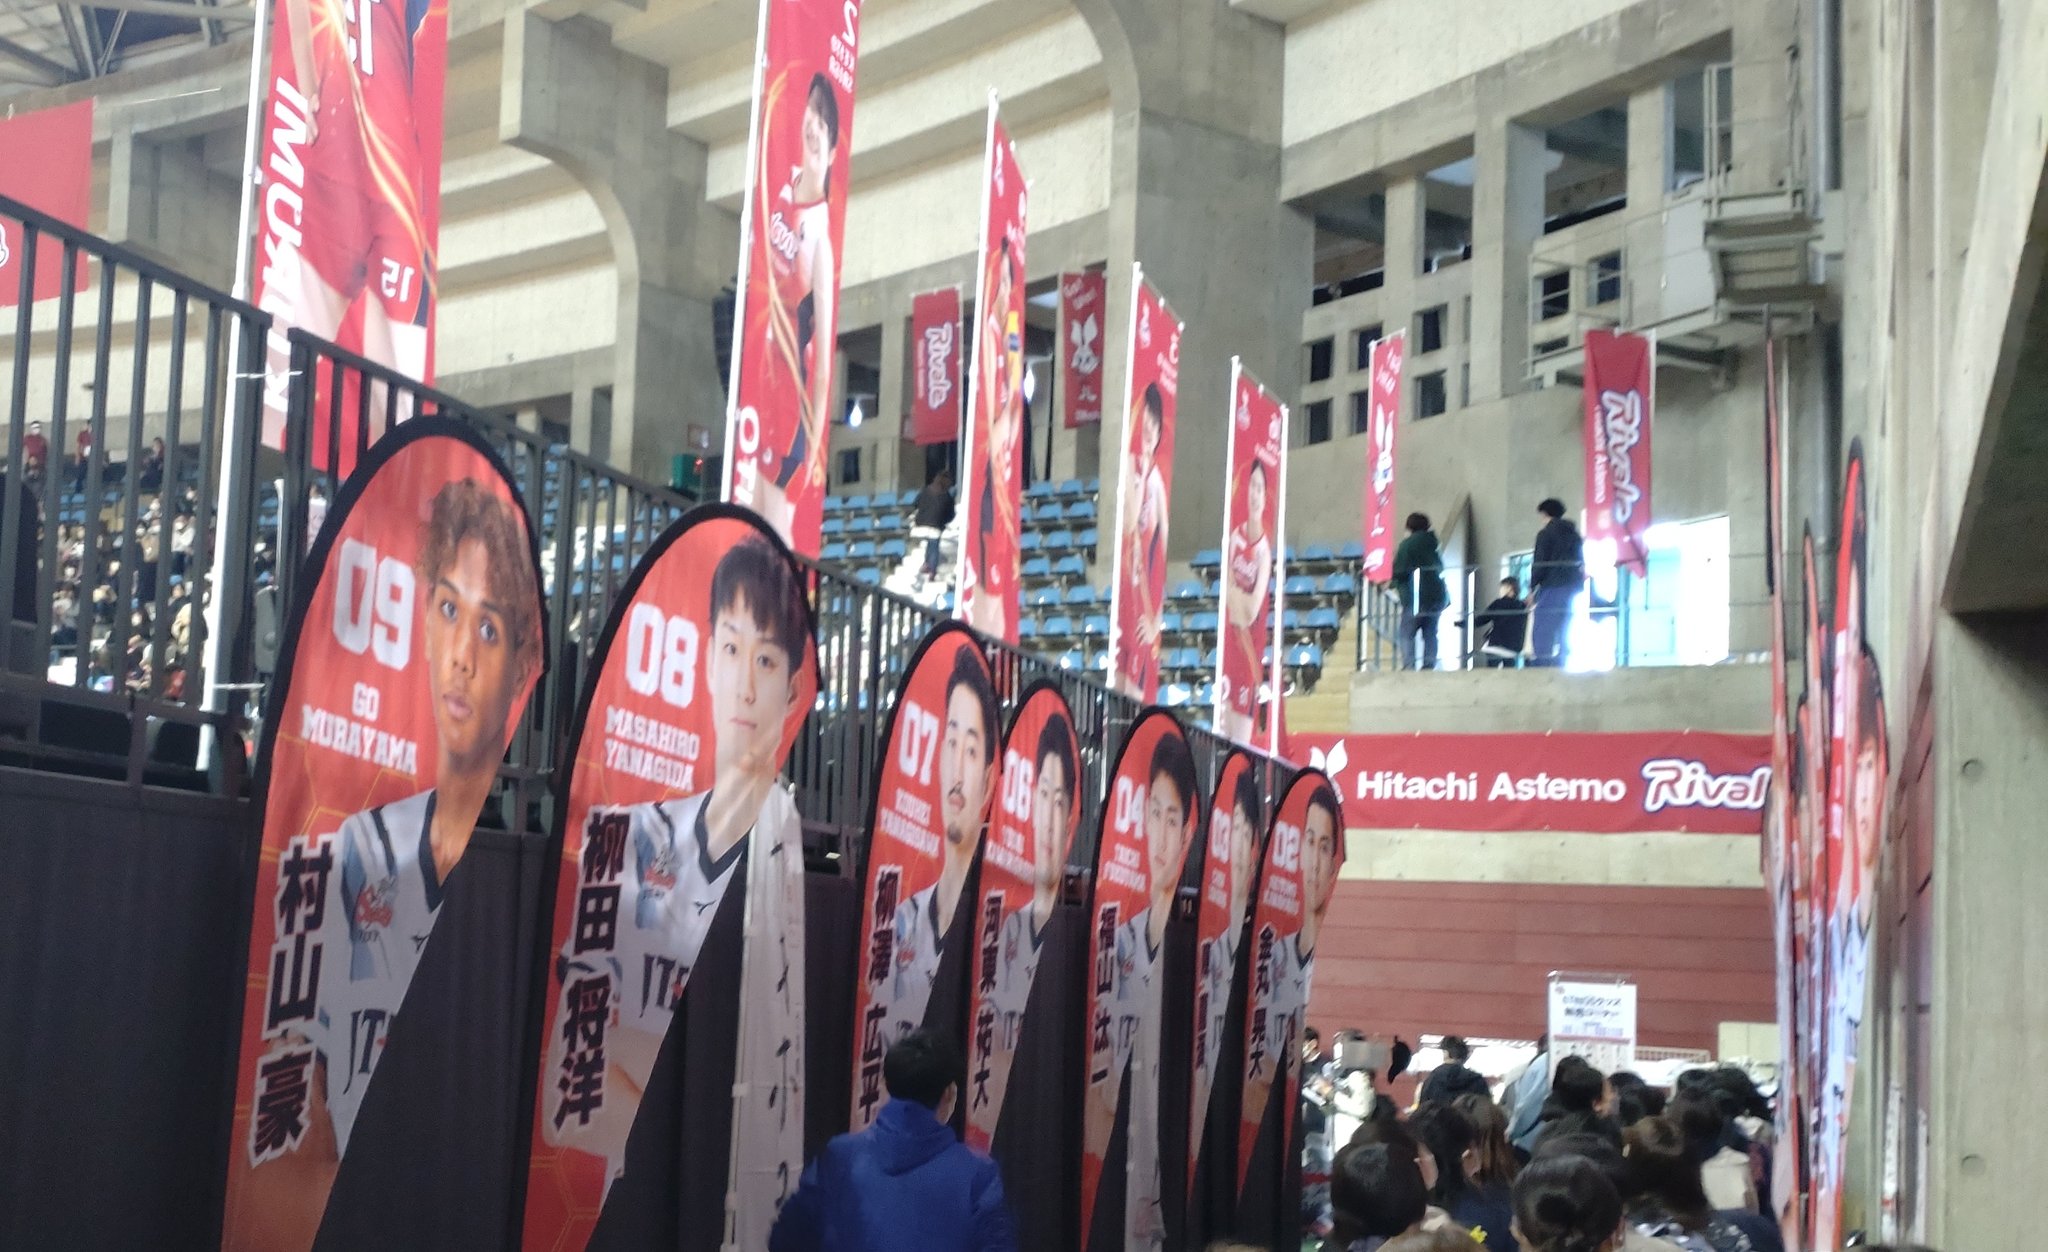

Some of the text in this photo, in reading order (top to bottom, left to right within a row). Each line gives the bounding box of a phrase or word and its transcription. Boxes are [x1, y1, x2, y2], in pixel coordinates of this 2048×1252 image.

[333, 537, 415, 671] 09
[624, 601, 699, 708] 08
[351, 681, 380, 721] GO
[605, 704, 701, 761] MASAHIRO
[302, 704, 417, 775] MURAYAMA
[604, 738, 695, 793] YANAGIDA
[899, 700, 940, 785] 07
[1114, 775, 1146, 839] 04
[1357, 759, 1773, 813] Hitachi Astemo Rival
[1272, 820, 1301, 873] 02
[573, 811, 632, 957] 柳田
[253, 841, 334, 1159] 村山 豪
